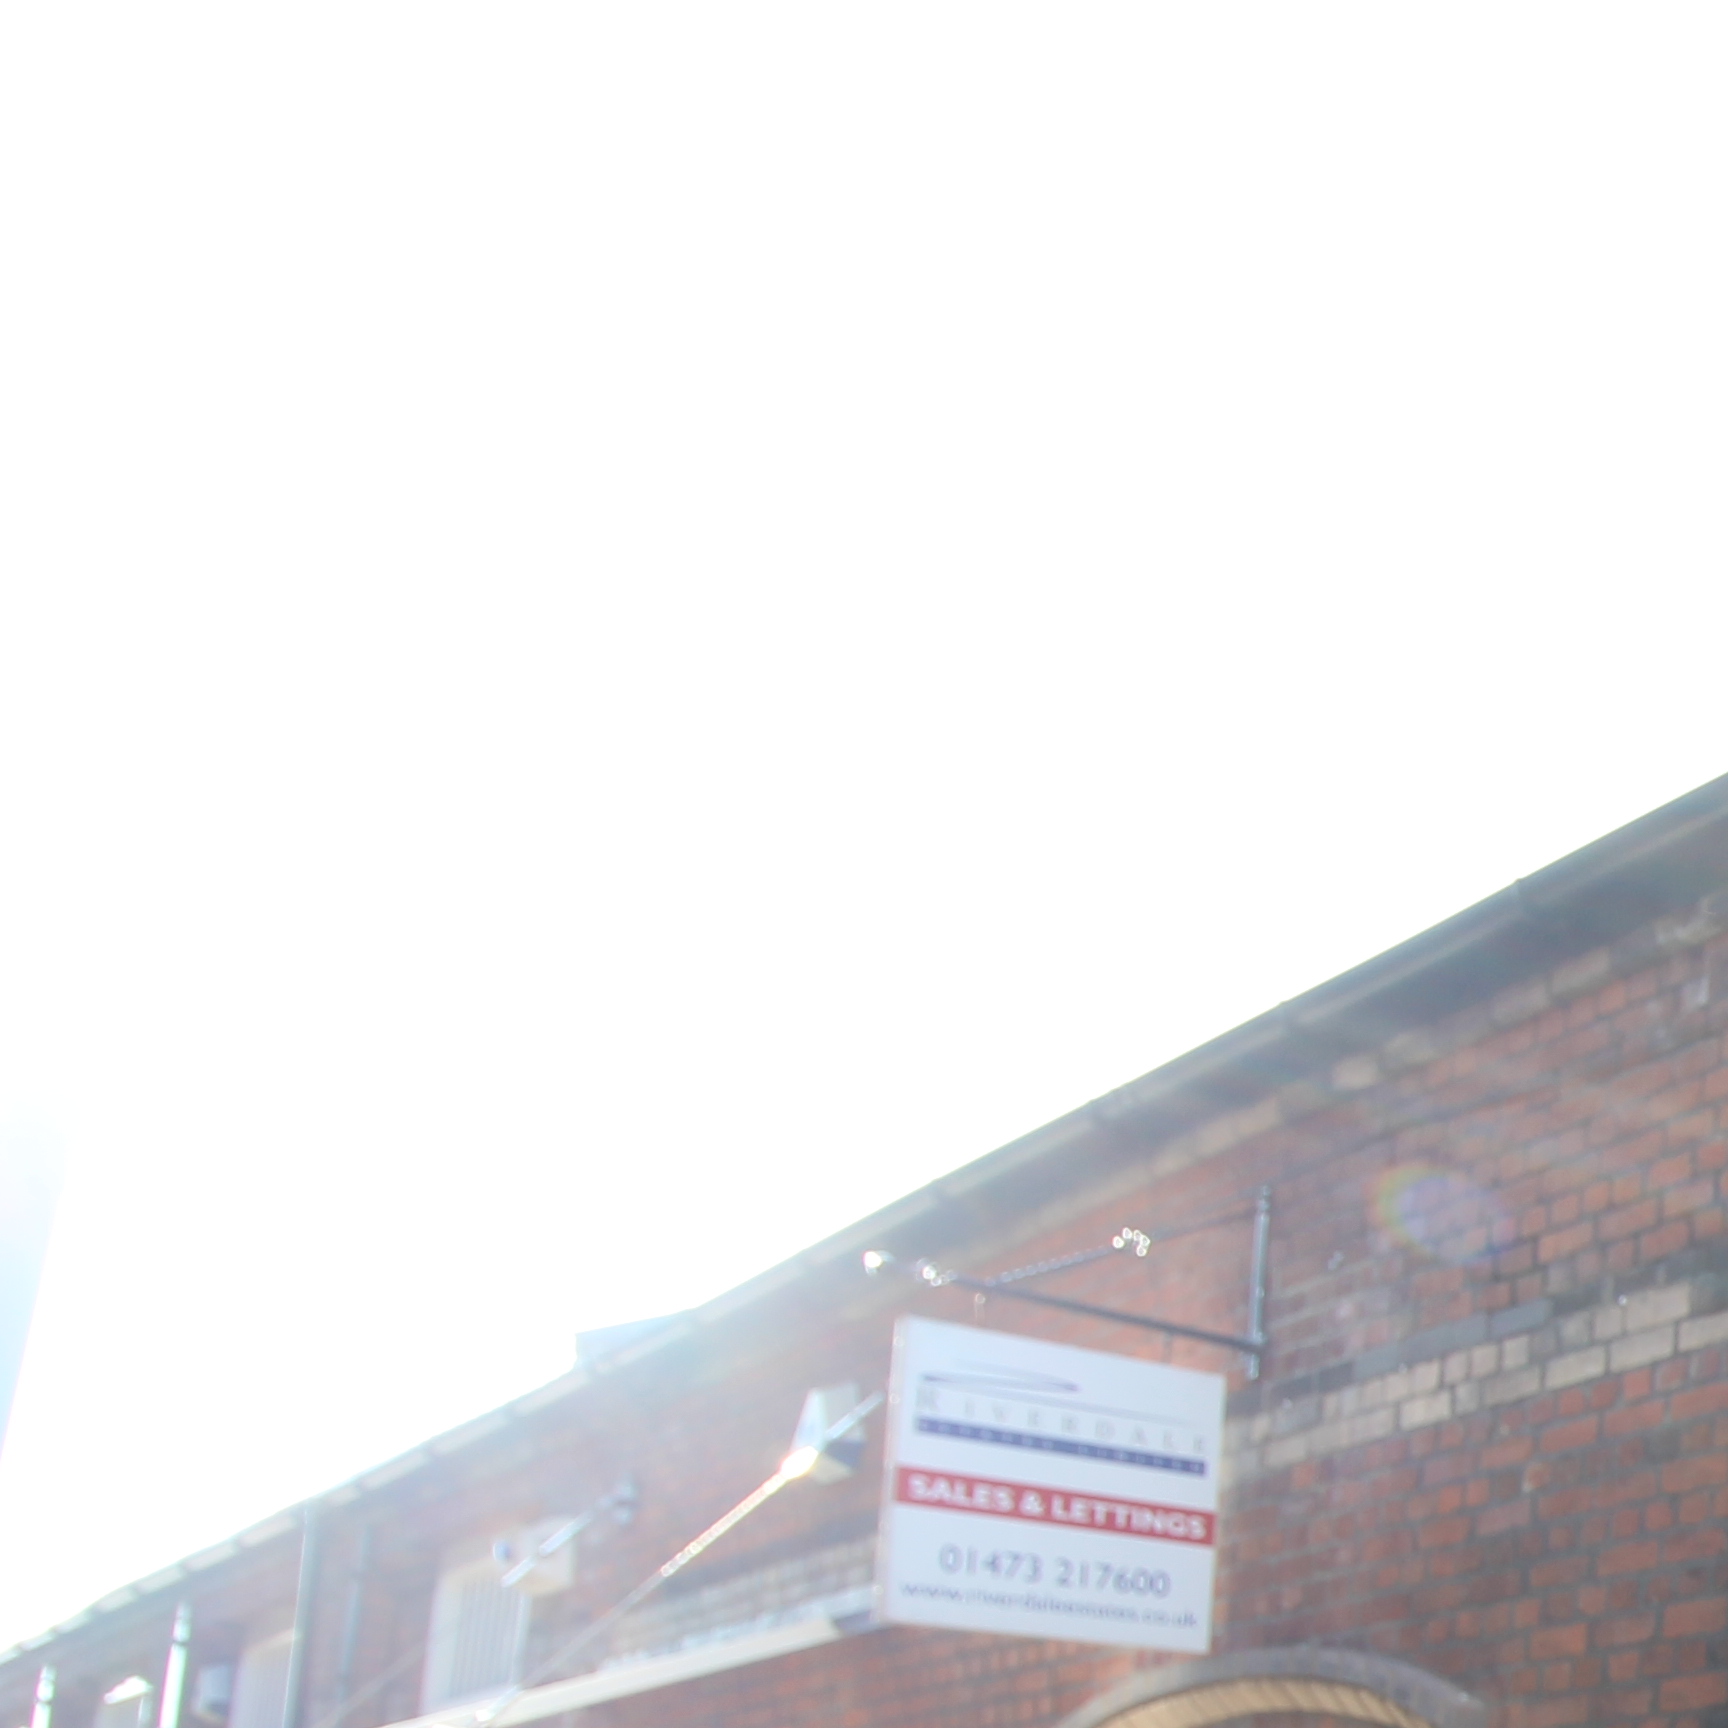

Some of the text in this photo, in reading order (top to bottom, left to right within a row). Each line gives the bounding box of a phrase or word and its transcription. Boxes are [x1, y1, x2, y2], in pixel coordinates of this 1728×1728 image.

[916, 1386, 1206, 1452] RIVERDALE
[907, 1473, 1206, 1539] SALES & LETTINGS
[939, 1542, 1172, 1598] 01473 217600
